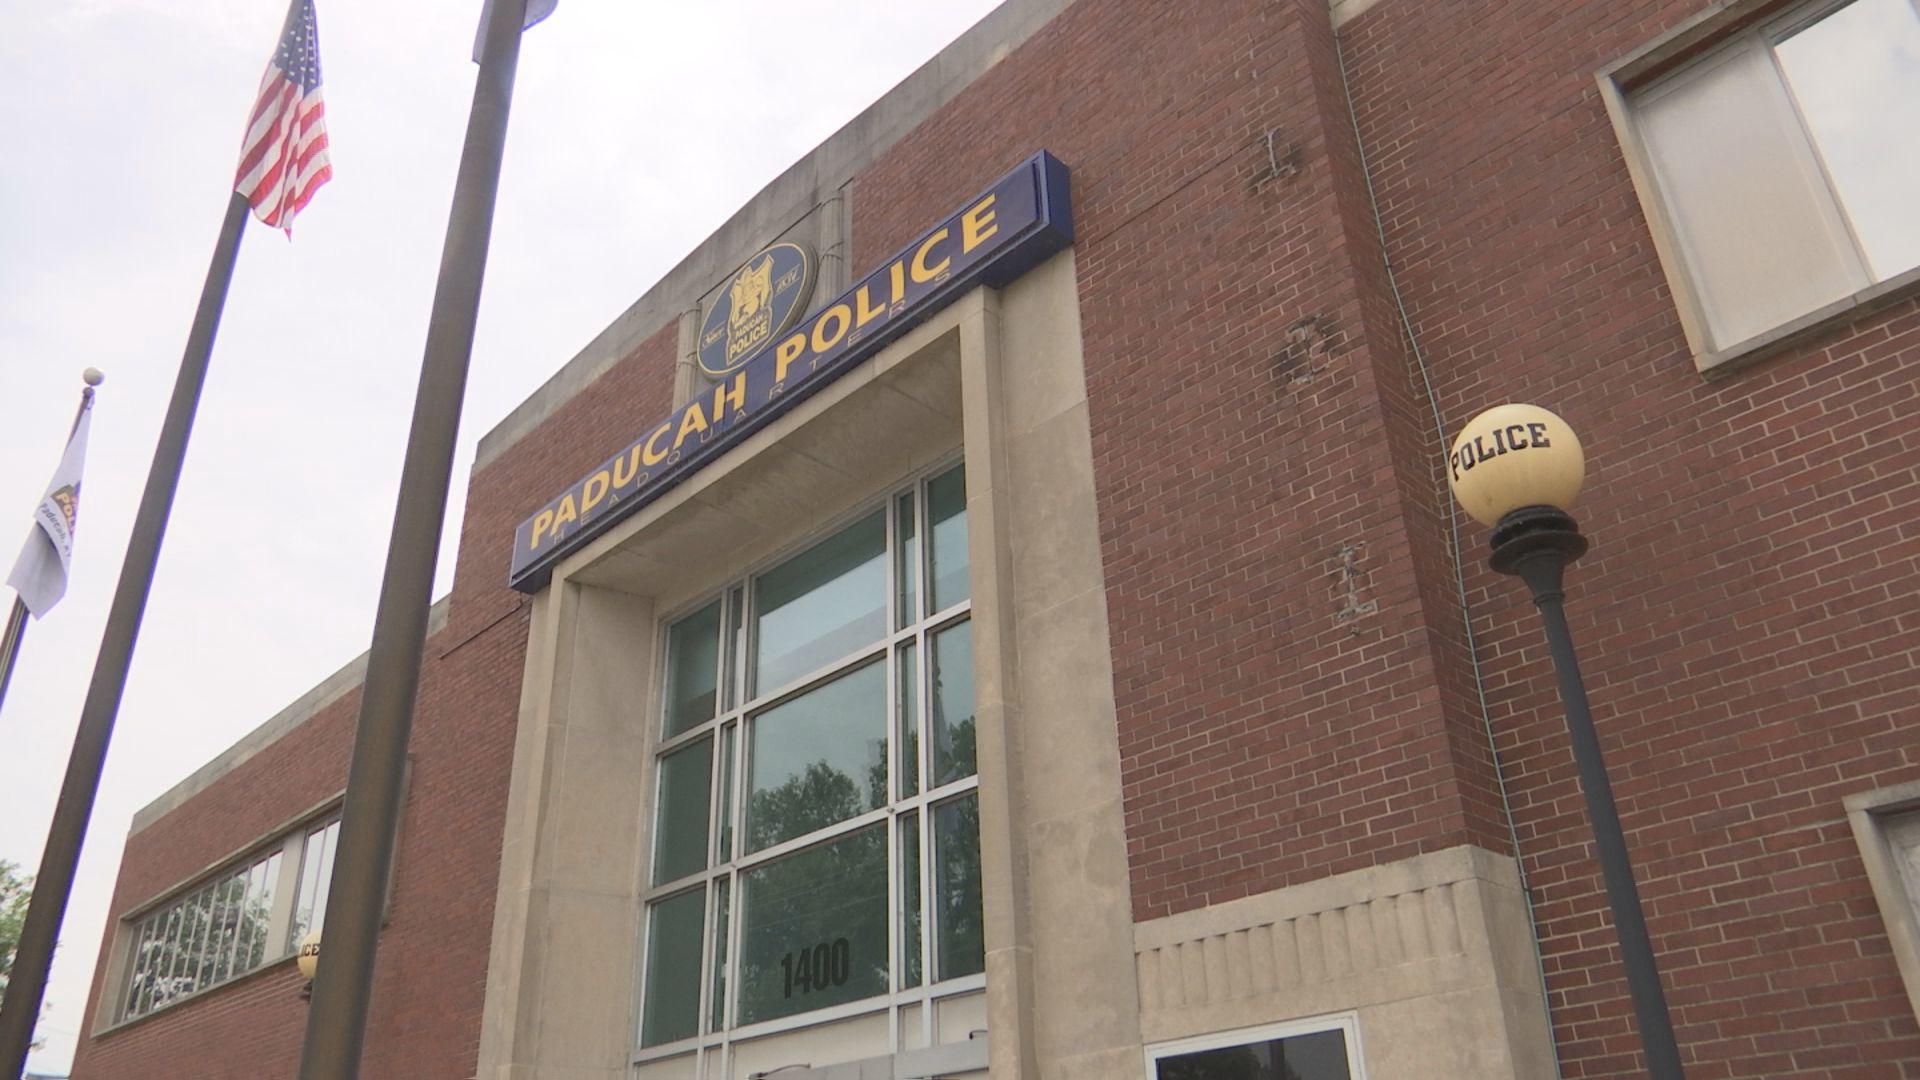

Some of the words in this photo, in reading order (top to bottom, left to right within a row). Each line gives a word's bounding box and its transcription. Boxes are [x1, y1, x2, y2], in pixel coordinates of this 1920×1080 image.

[729, 320, 768, 359] POLICE
[530, 369, 746, 550] PADUCAH
[775, 193, 998, 384] POLICE
[553, 267, 951, 546] HEADQUARTERS
[1450, 422, 1552, 482] POLICE
[780, 937, 850, 999] 1400
